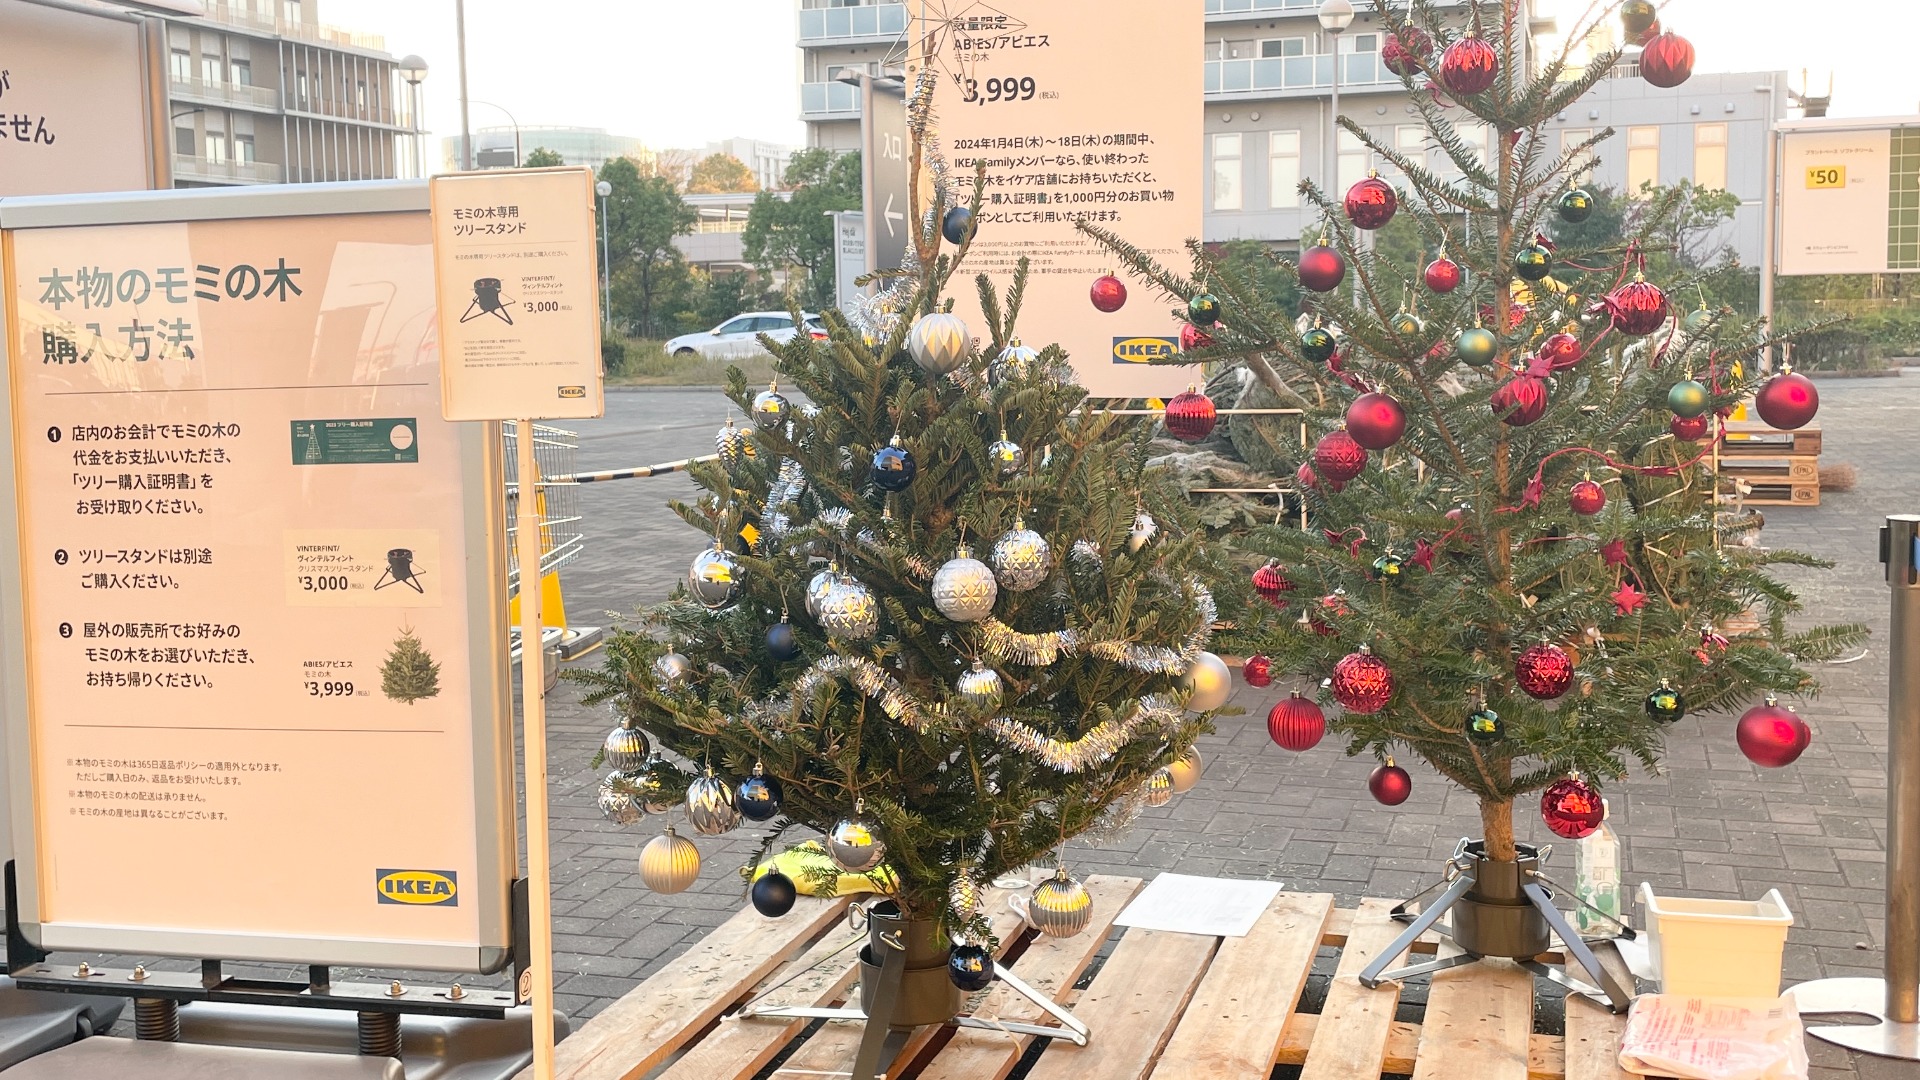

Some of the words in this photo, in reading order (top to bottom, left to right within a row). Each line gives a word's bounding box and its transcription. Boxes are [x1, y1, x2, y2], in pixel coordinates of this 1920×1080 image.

[953, 74, 1036, 106] ¥3,999
[883, 132, 902, 161] 入口
[1809, 169, 1839, 184] ¥50
[453, 206, 519, 220] モミの木専用
[976, 210, 1122, 224] ポンとしてご利用いただけます。
[453, 222, 527, 236] ツリースタンド
[38, 258, 303, 310] 本物のモミの木
[523, 301, 558, 314] ¥3,000
[42, 317, 195, 364] 購入方法
[1119, 344, 1172, 355] IKEA
[72, 422, 241, 442] 店内のお会計でモミの木の
[73, 448, 232, 466] 代金をお支払いいただき、
[76, 499, 204, 515] お受け取りください。
[79, 548, 213, 564] ツリースタンドは別途
[81, 573, 180, 589] ご購入ください。
[298, 576, 348, 592] ¥3,000
[83, 622, 241, 639] 屋外の販売所でお好みの
[85, 647, 255, 664] モミの木をお選びいただき、
[86, 671, 213, 688] お持ち帰りください。
[304, 681, 354, 698] ¥3,999
[385, 879, 452, 895] IKEA
